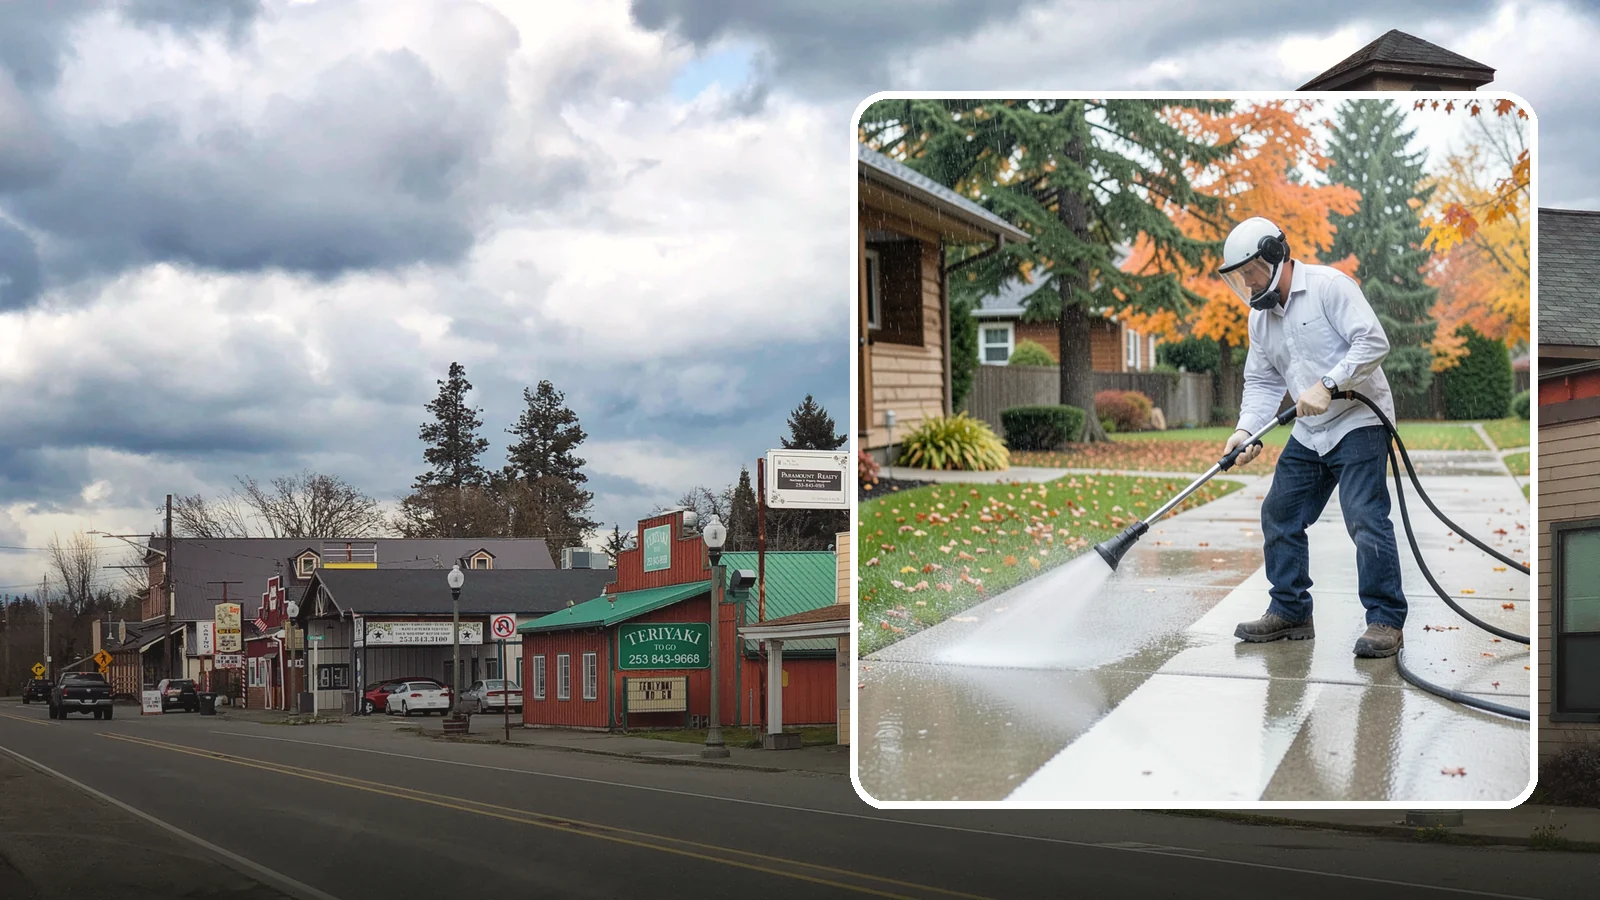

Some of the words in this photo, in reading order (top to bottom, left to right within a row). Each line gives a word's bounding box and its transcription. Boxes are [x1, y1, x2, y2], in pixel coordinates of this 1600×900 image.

[781, 471, 814, 479] PARAMOUNT
[817, 472, 838, 480] REALTY
[625, 627, 702, 646] TERIYAKI
[629, 654, 649, 664] 253
[651, 653, 700, 664] 843-9668
